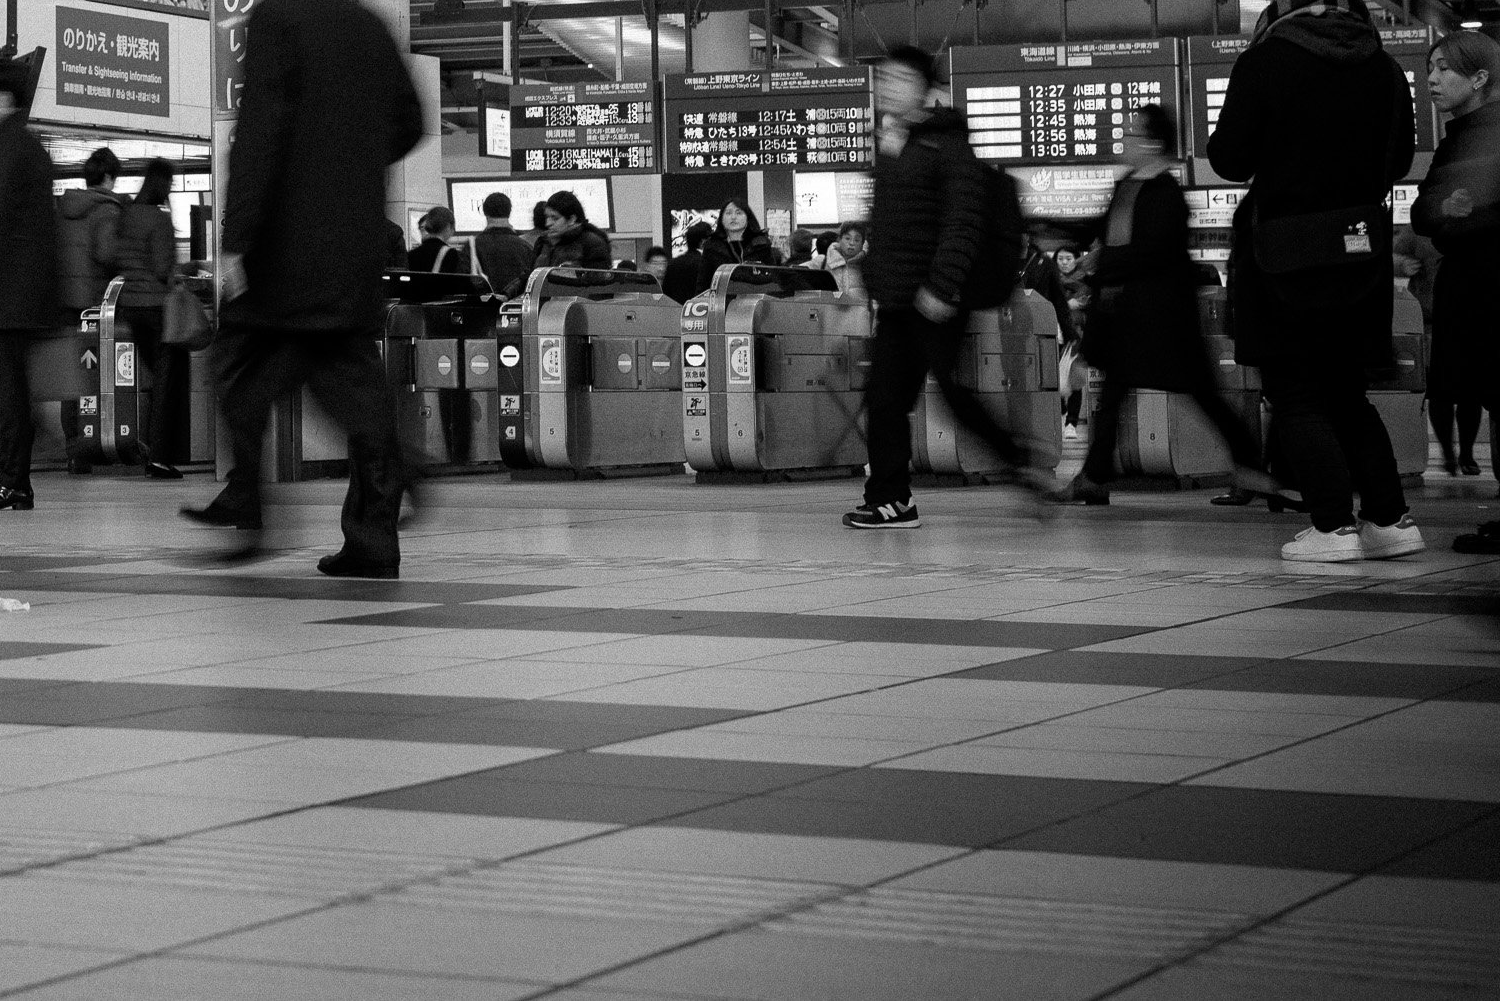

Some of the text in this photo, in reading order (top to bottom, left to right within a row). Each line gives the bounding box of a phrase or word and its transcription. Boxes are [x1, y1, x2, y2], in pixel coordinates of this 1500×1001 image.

[63, 27, 160, 62] のりかえ・観光案内
[1020, 47, 1055, 58] 東海道線
[1044, 54, 1056, 62] Line
[61, 61, 162, 85] Transfer & Sightseeing Information
[1028, 84, 1066, 98] 12:27
[1073, 83, 1106, 97] 小田原
[545, 105, 572, 117] 12:20
[1029, 98, 1107, 113] 12:35 小田原
[545, 116, 573, 127] 12:33
[758, 110, 787, 123] 12:17
[1029, 114, 1067, 128] 12:45
[758, 124, 787, 137] 12:45
[1029, 129, 1067, 142] 12:56
[758, 138, 787, 151] 12:54
[1030, 144, 1068, 158] 13:05
[545, 148, 573, 160] 12:16
[759, 152, 788, 165] 13:15
[545, 158, 573, 170] 12:23
[684, 301, 710, 317] IC
[684, 319, 704, 331] 専用
